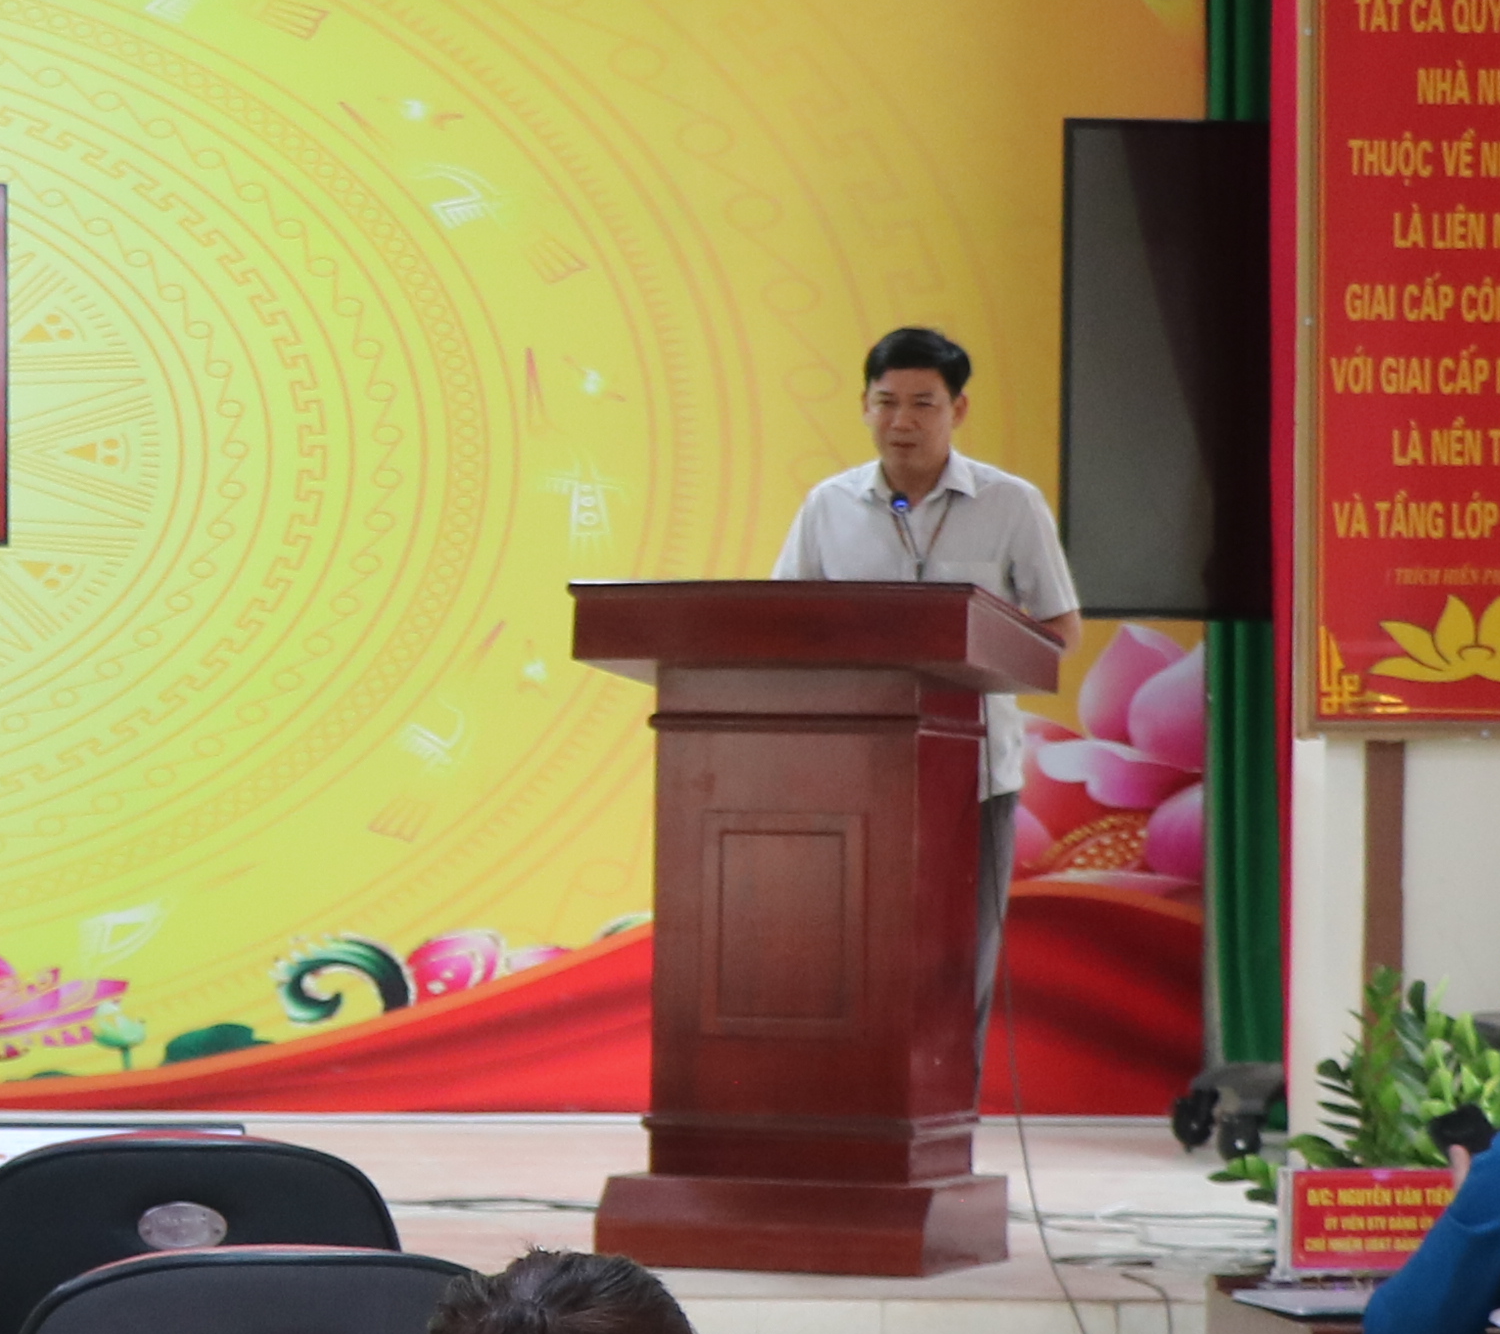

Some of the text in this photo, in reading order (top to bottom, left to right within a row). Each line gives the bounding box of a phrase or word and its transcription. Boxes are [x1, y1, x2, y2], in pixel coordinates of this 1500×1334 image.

[1417, 60, 1471, 105] NHÀ
[1348, 131, 1434, 186] THUỘC
[1442, 127, 1476, 178] VỀ
[1393, 203, 1425, 248] LÀ
[1432, 204, 1486, 249] LIÊN
[1345, 284, 1395, 321] GIAI
[1403, 272, 1455, 322] CẤP
[1330, 345, 1372, 395] VỚI
[1380, 356, 1432, 395] GIAI
[1438, 344, 1490, 395] CẤP
[1392, 419, 1424, 466] LÀ
[1431, 416, 1482, 466] NỀN
[1332, 493, 1370, 538] VÀ
[1375, 490, 1444, 539] TẦNG
[1451, 492, 1500, 539] LỚP
